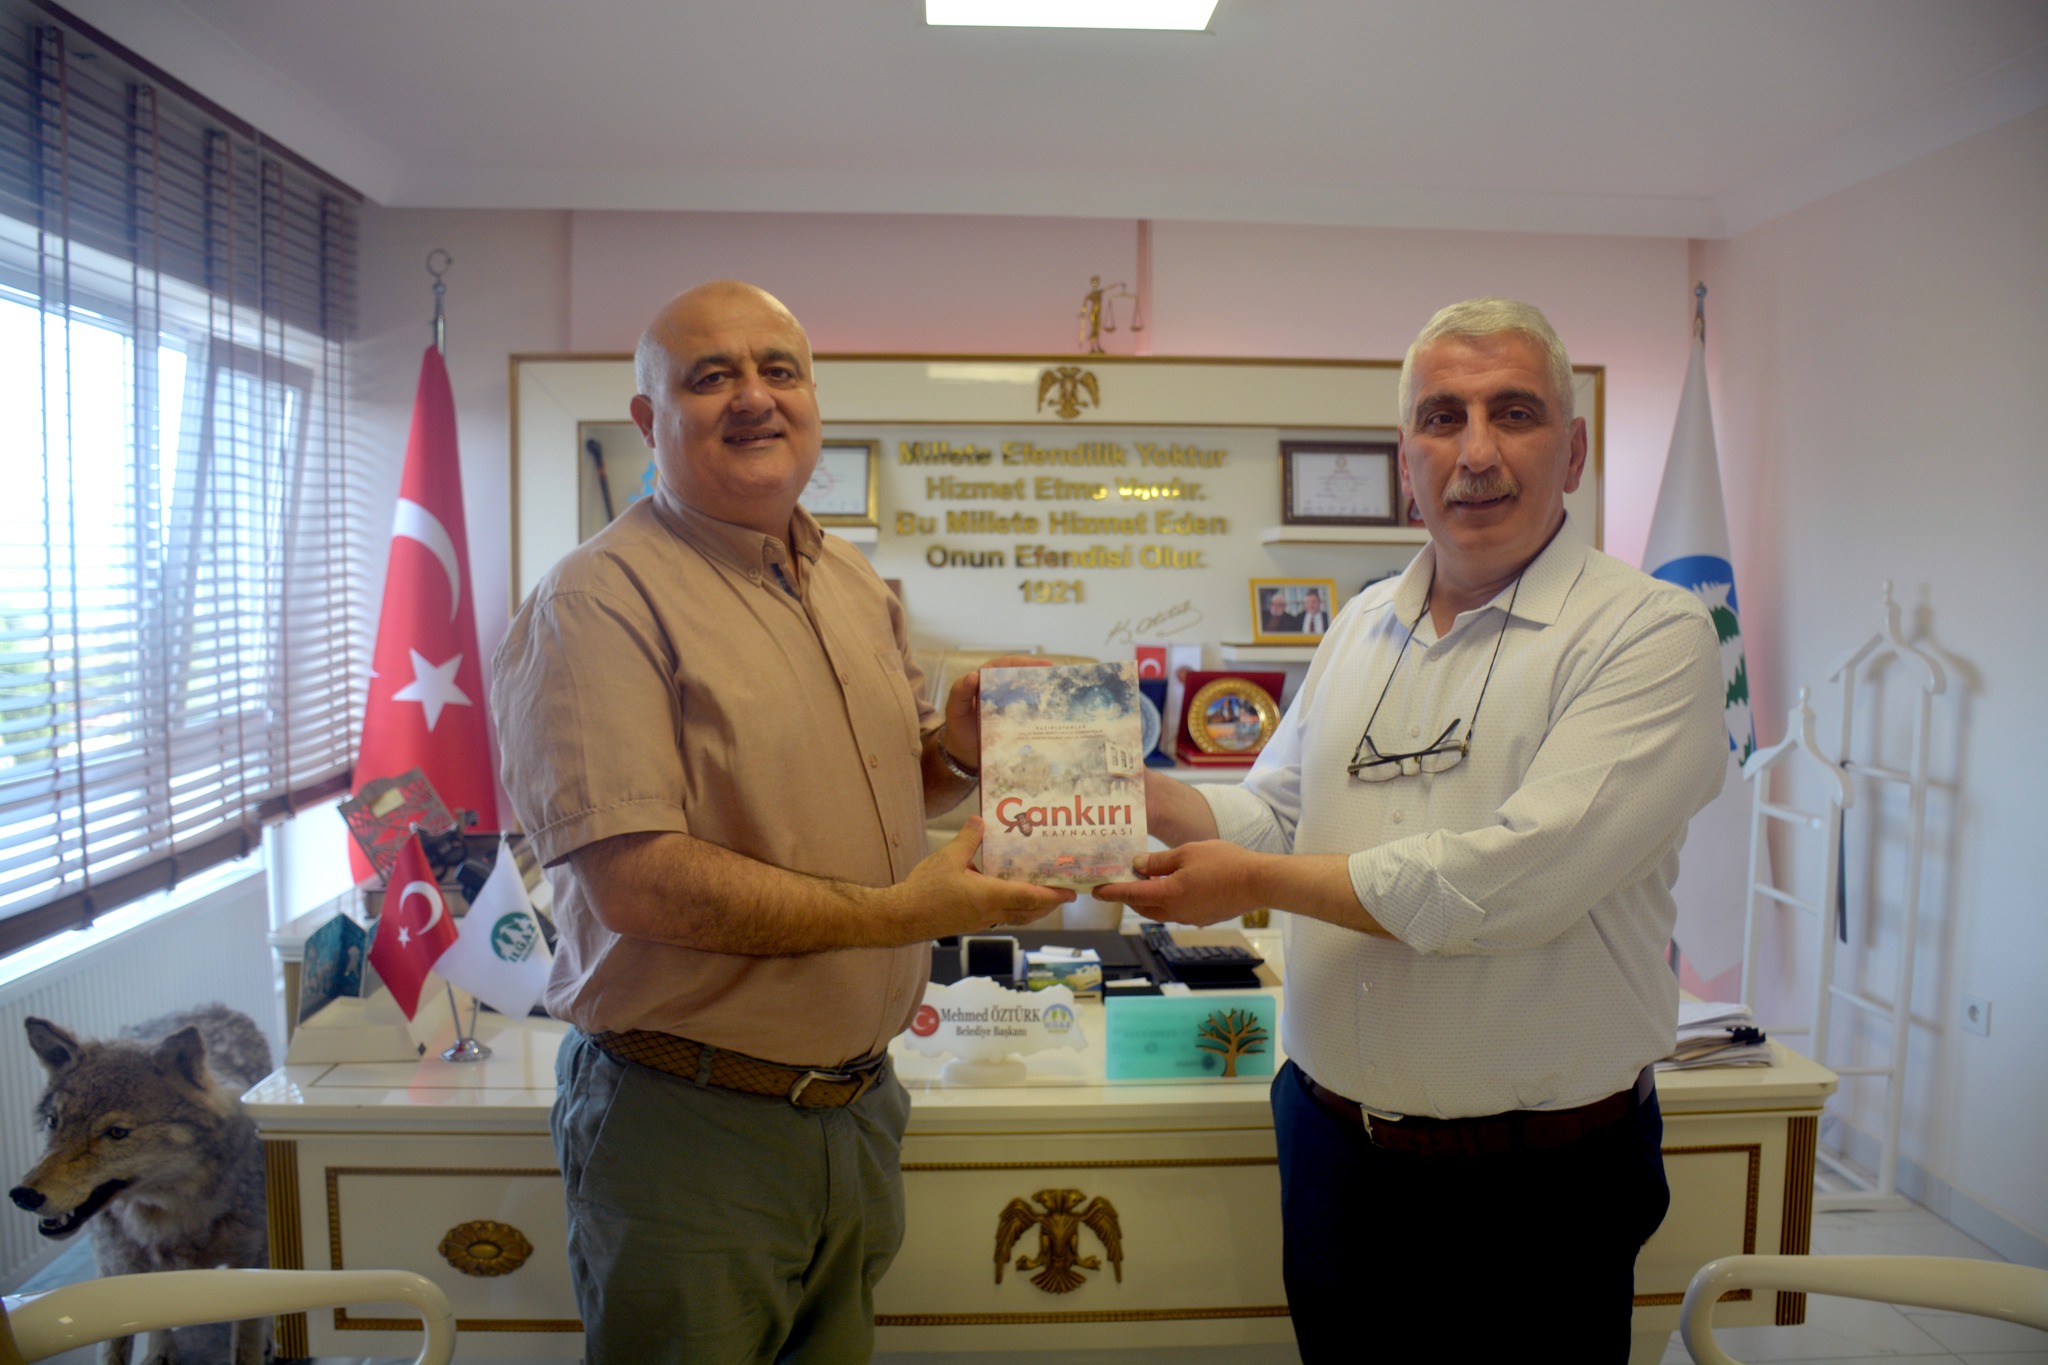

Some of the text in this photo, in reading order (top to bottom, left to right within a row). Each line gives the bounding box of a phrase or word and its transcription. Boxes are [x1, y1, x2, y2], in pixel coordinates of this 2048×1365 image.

[898, 441, 1227, 467] Millete Efendilik Yoktur
[926, 476, 1024, 500] Hizmet
[1034, 476, 1107, 500] Etme
[896, 510, 1227, 535] Bu Millete Hizmet Eden
[927, 544, 1208, 569] Onun Efendisi Olur.
[1019, 580, 1083, 603] 1921
[996, 795, 1132, 833] Çankırı
[1042, 828, 1132, 837] KAYNAKÇASI
[941, 1005, 1041, 1023] Mehmed ÖZTÜRK
[956, 1026, 1027, 1038] Belediye Başkanı
